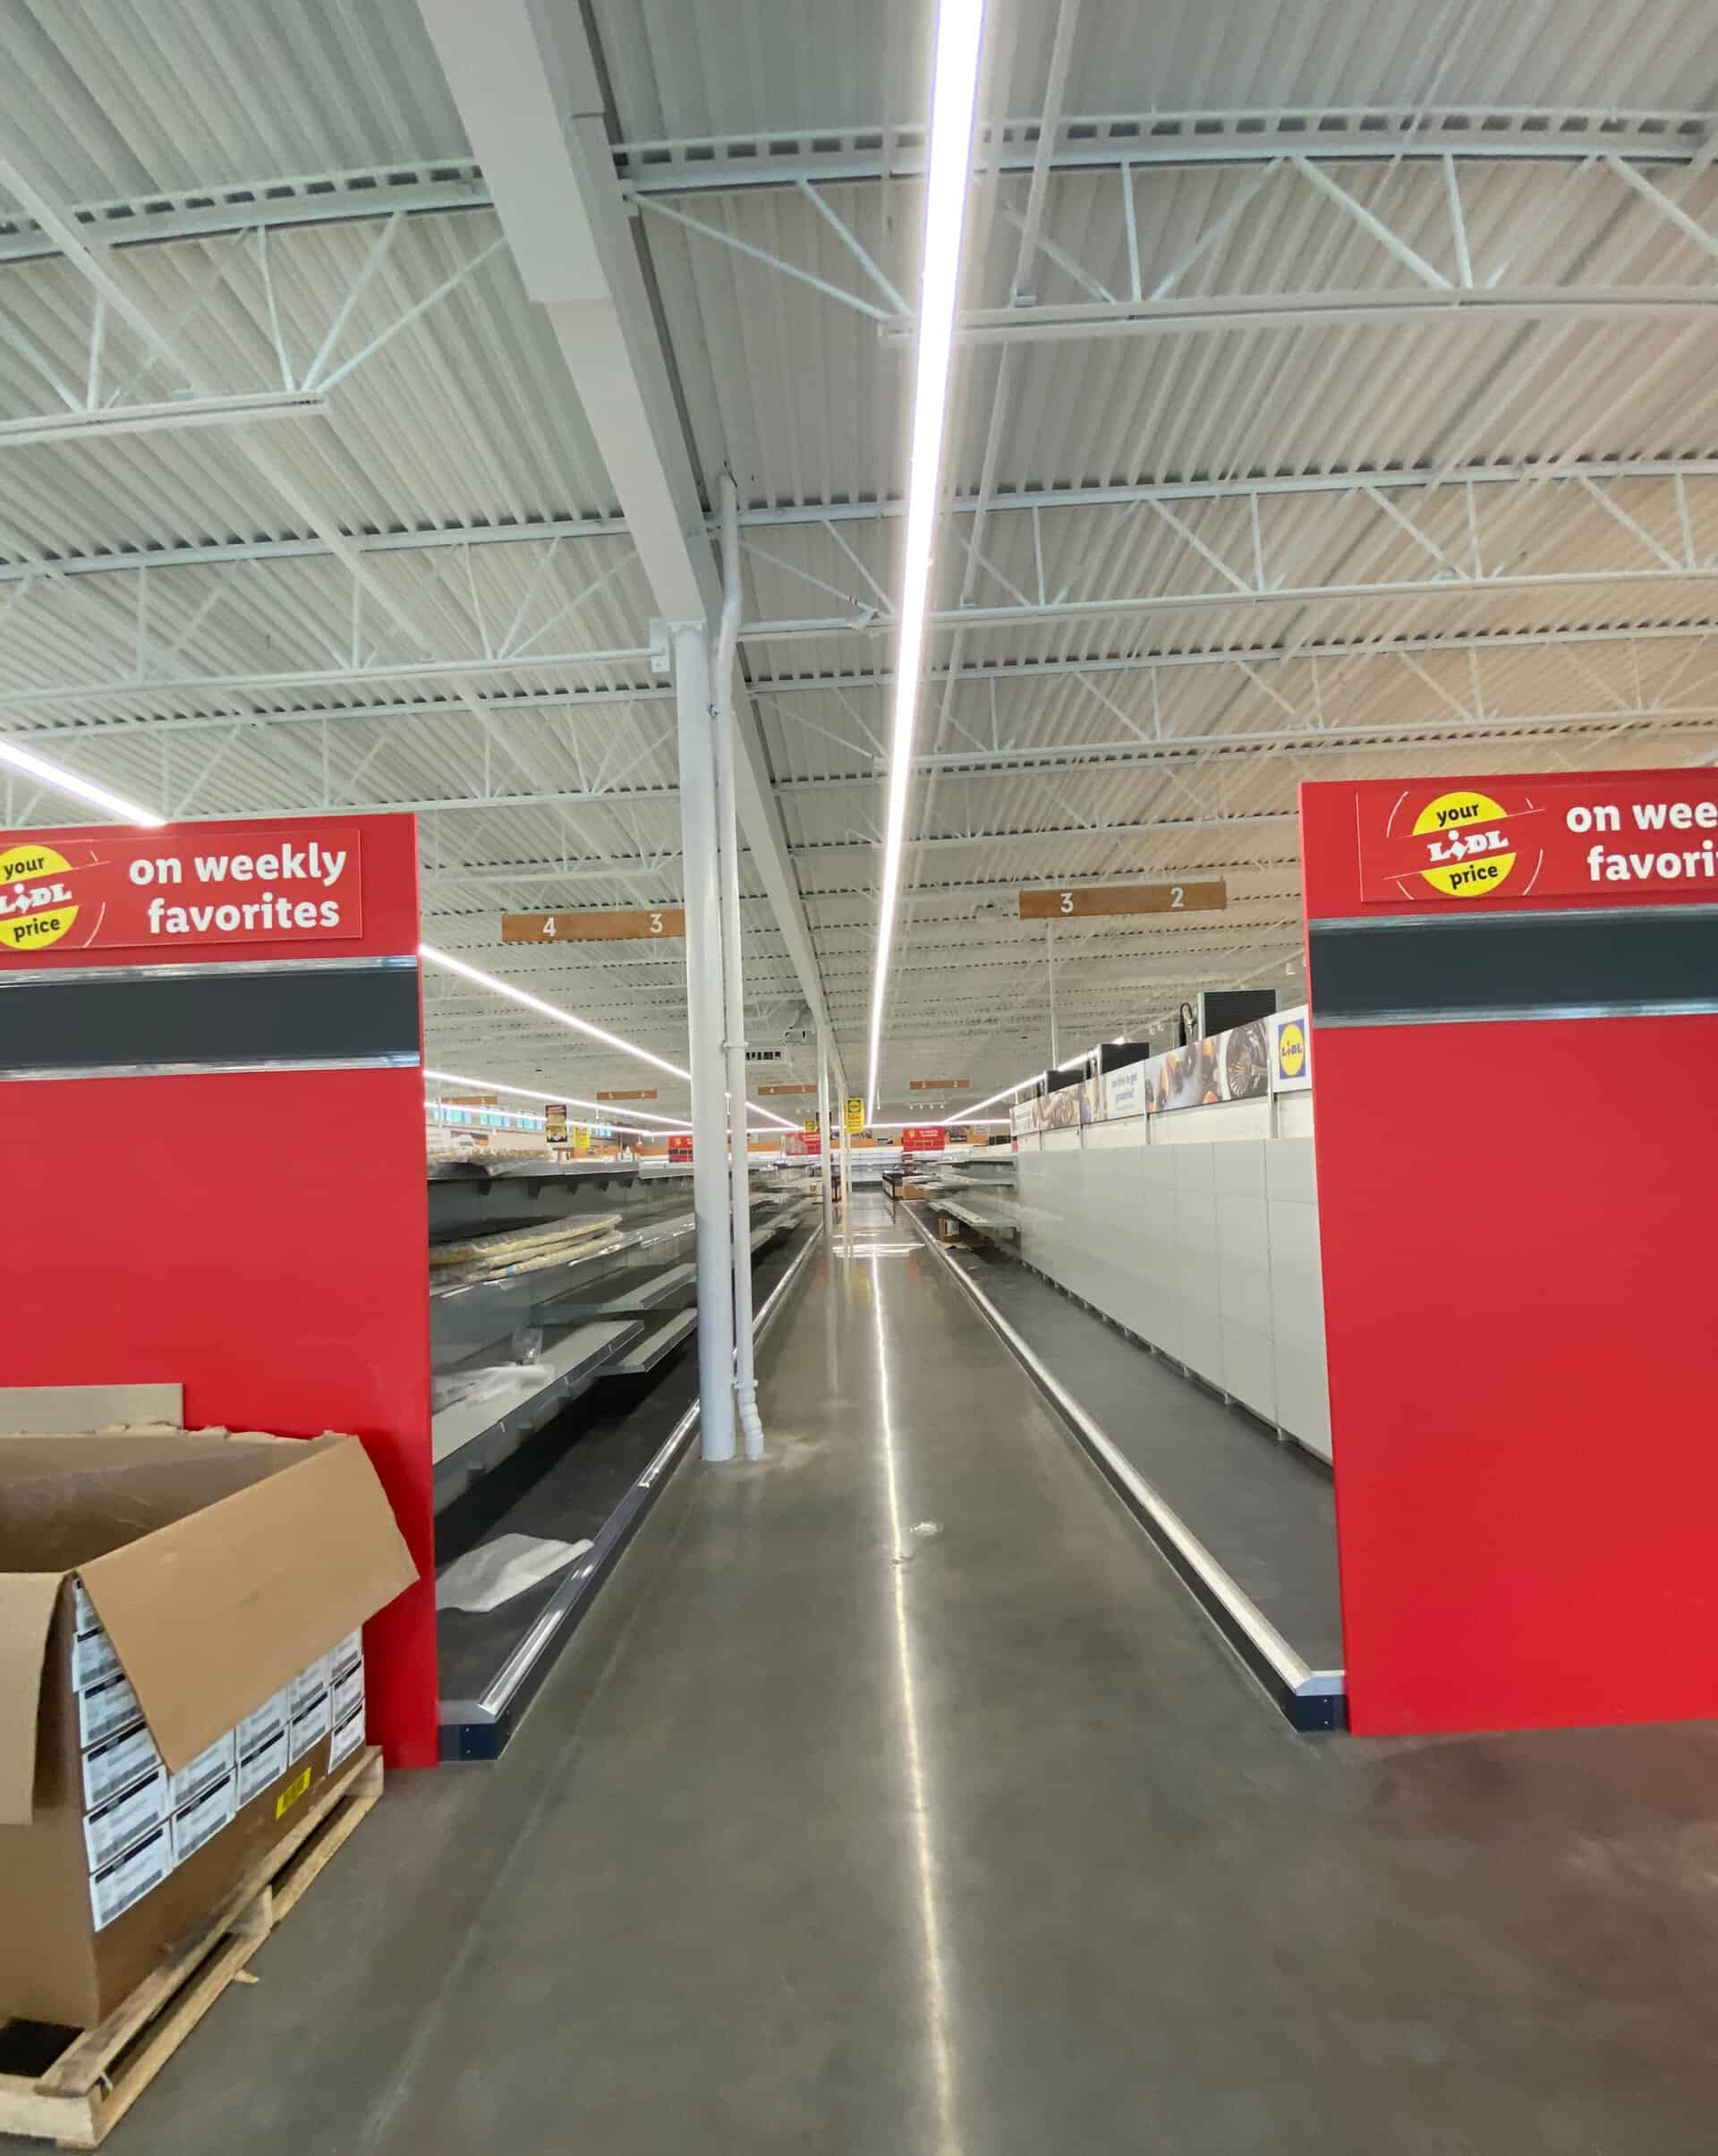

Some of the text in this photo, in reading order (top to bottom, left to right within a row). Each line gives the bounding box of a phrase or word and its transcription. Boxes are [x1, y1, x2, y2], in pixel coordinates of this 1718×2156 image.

[1436, 804, 1479, 827] your
[1567, 805, 1620, 832] on
[4, 857, 45, 880] your
[129, 843, 347, 886] on weekly
[1587, 839, 1718, 881] favori
[1450, 865, 1498, 890] price
[1061, 888, 1184, 913] 3 2
[148, 893, 340, 934] favorites
[542, 914, 663, 937] 4 3
[13, 917, 60, 942] price
